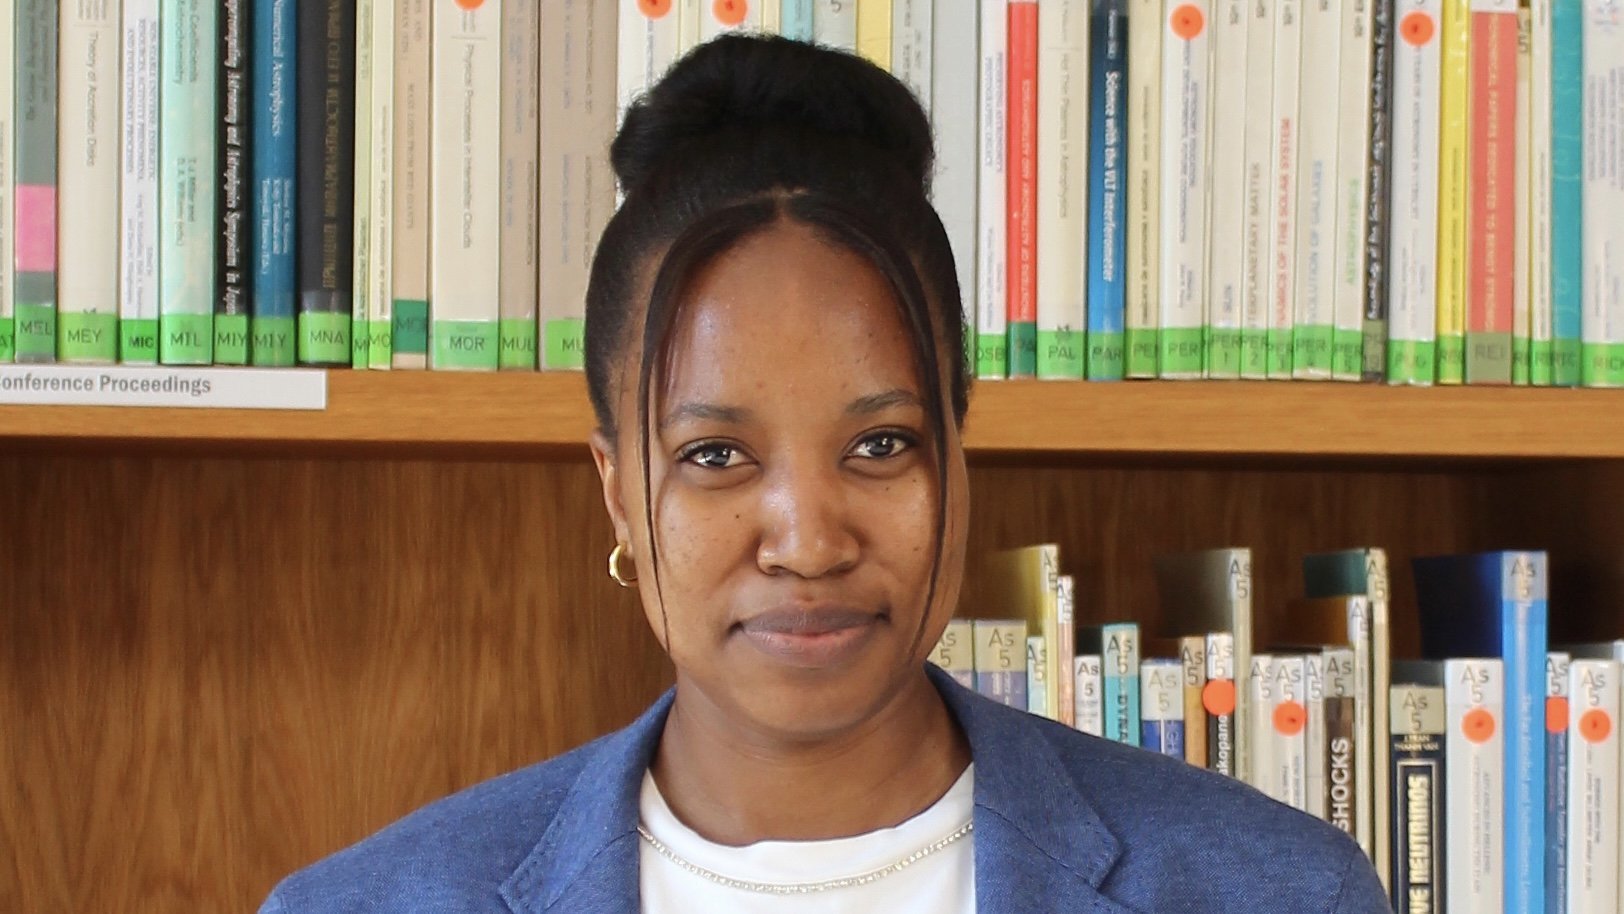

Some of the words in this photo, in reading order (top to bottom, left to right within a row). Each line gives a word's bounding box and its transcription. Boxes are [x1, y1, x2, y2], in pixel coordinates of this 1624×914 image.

[85, 31, 99, 68] Theory
[463, 45, 474, 87] Physical
[268, 61, 284, 137] Astrophysics
[1103, 71, 1118, 116] Science
[85, 85, 99, 133] Accretion
[1487, 90, 1498, 138] PAPERS
[224, 126, 241, 145] and
[1103, 118, 1118, 146] with
[85, 138, 99, 167] Disks
[1280, 119, 1289, 169] SYSTEM
[1103, 148, 1118, 168] the
[1103, 170, 1118, 190] VLT
[1249, 163, 1260, 214] MATTER
[463, 212, 474, 249] Clouds
[1103, 192, 1118, 281] Interferometer
[224, 272, 241, 283] in
[1223, 286, 1232, 313] SUN
[20, 320, 53, 338] MEL
[67, 328, 102, 345] MEY
[309, 331, 346, 346] MNA
[129, 335, 155, 349] MIC
[170, 332, 202, 348] MIL
[217, 332, 247, 348] MIY
[450, 334, 487, 351] MOR
[502, 335, 535, 352] MUL
[1168, 341, 1200, 358] PER
[1048, 345, 1076, 362] PAL
[99, 374, 212, 397] Proceedings
[1510, 558, 1536, 578] As
[1237, 578, 1248, 600] 5
[988, 627, 1014, 647] As
[1106, 634, 1132, 654] As
[940, 648, 952, 668] 5
[1000, 648, 1011, 668] 5
[1181, 645, 1203, 665] As
[1208, 641, 1233, 657] As
[1077, 662, 1099, 677] As
[1117, 654, 1128, 676] 5
[1215, 657, 1226, 678] 5
[1275, 664, 1301, 683] As
[1327, 656, 1352, 676] As
[1461, 664, 1489, 684] As
[1546, 657, 1568, 676] As
[1148, 668, 1176, 689] As
[1187, 666, 1199, 687] 5
[1550, 677, 1561, 695] 5
[1583, 668, 1605, 687] As
[1085, 683, 1094, 697] 5
[1261, 682, 1272, 699] 5
[1283, 682, 1294, 701] 5
[1310, 681, 1322, 699] 5
[1334, 677, 1346, 697] 5
[1471, 685, 1482, 703] 5
[1588, 687, 1600, 706] 5
[1158, 692, 1170, 712] 5
[1403, 692, 1427, 711] As
[1410, 712, 1422, 731] 5
[1331, 738, 1349, 832] SHOCKS
[1408, 773, 1430, 884] NEUTRINOS
